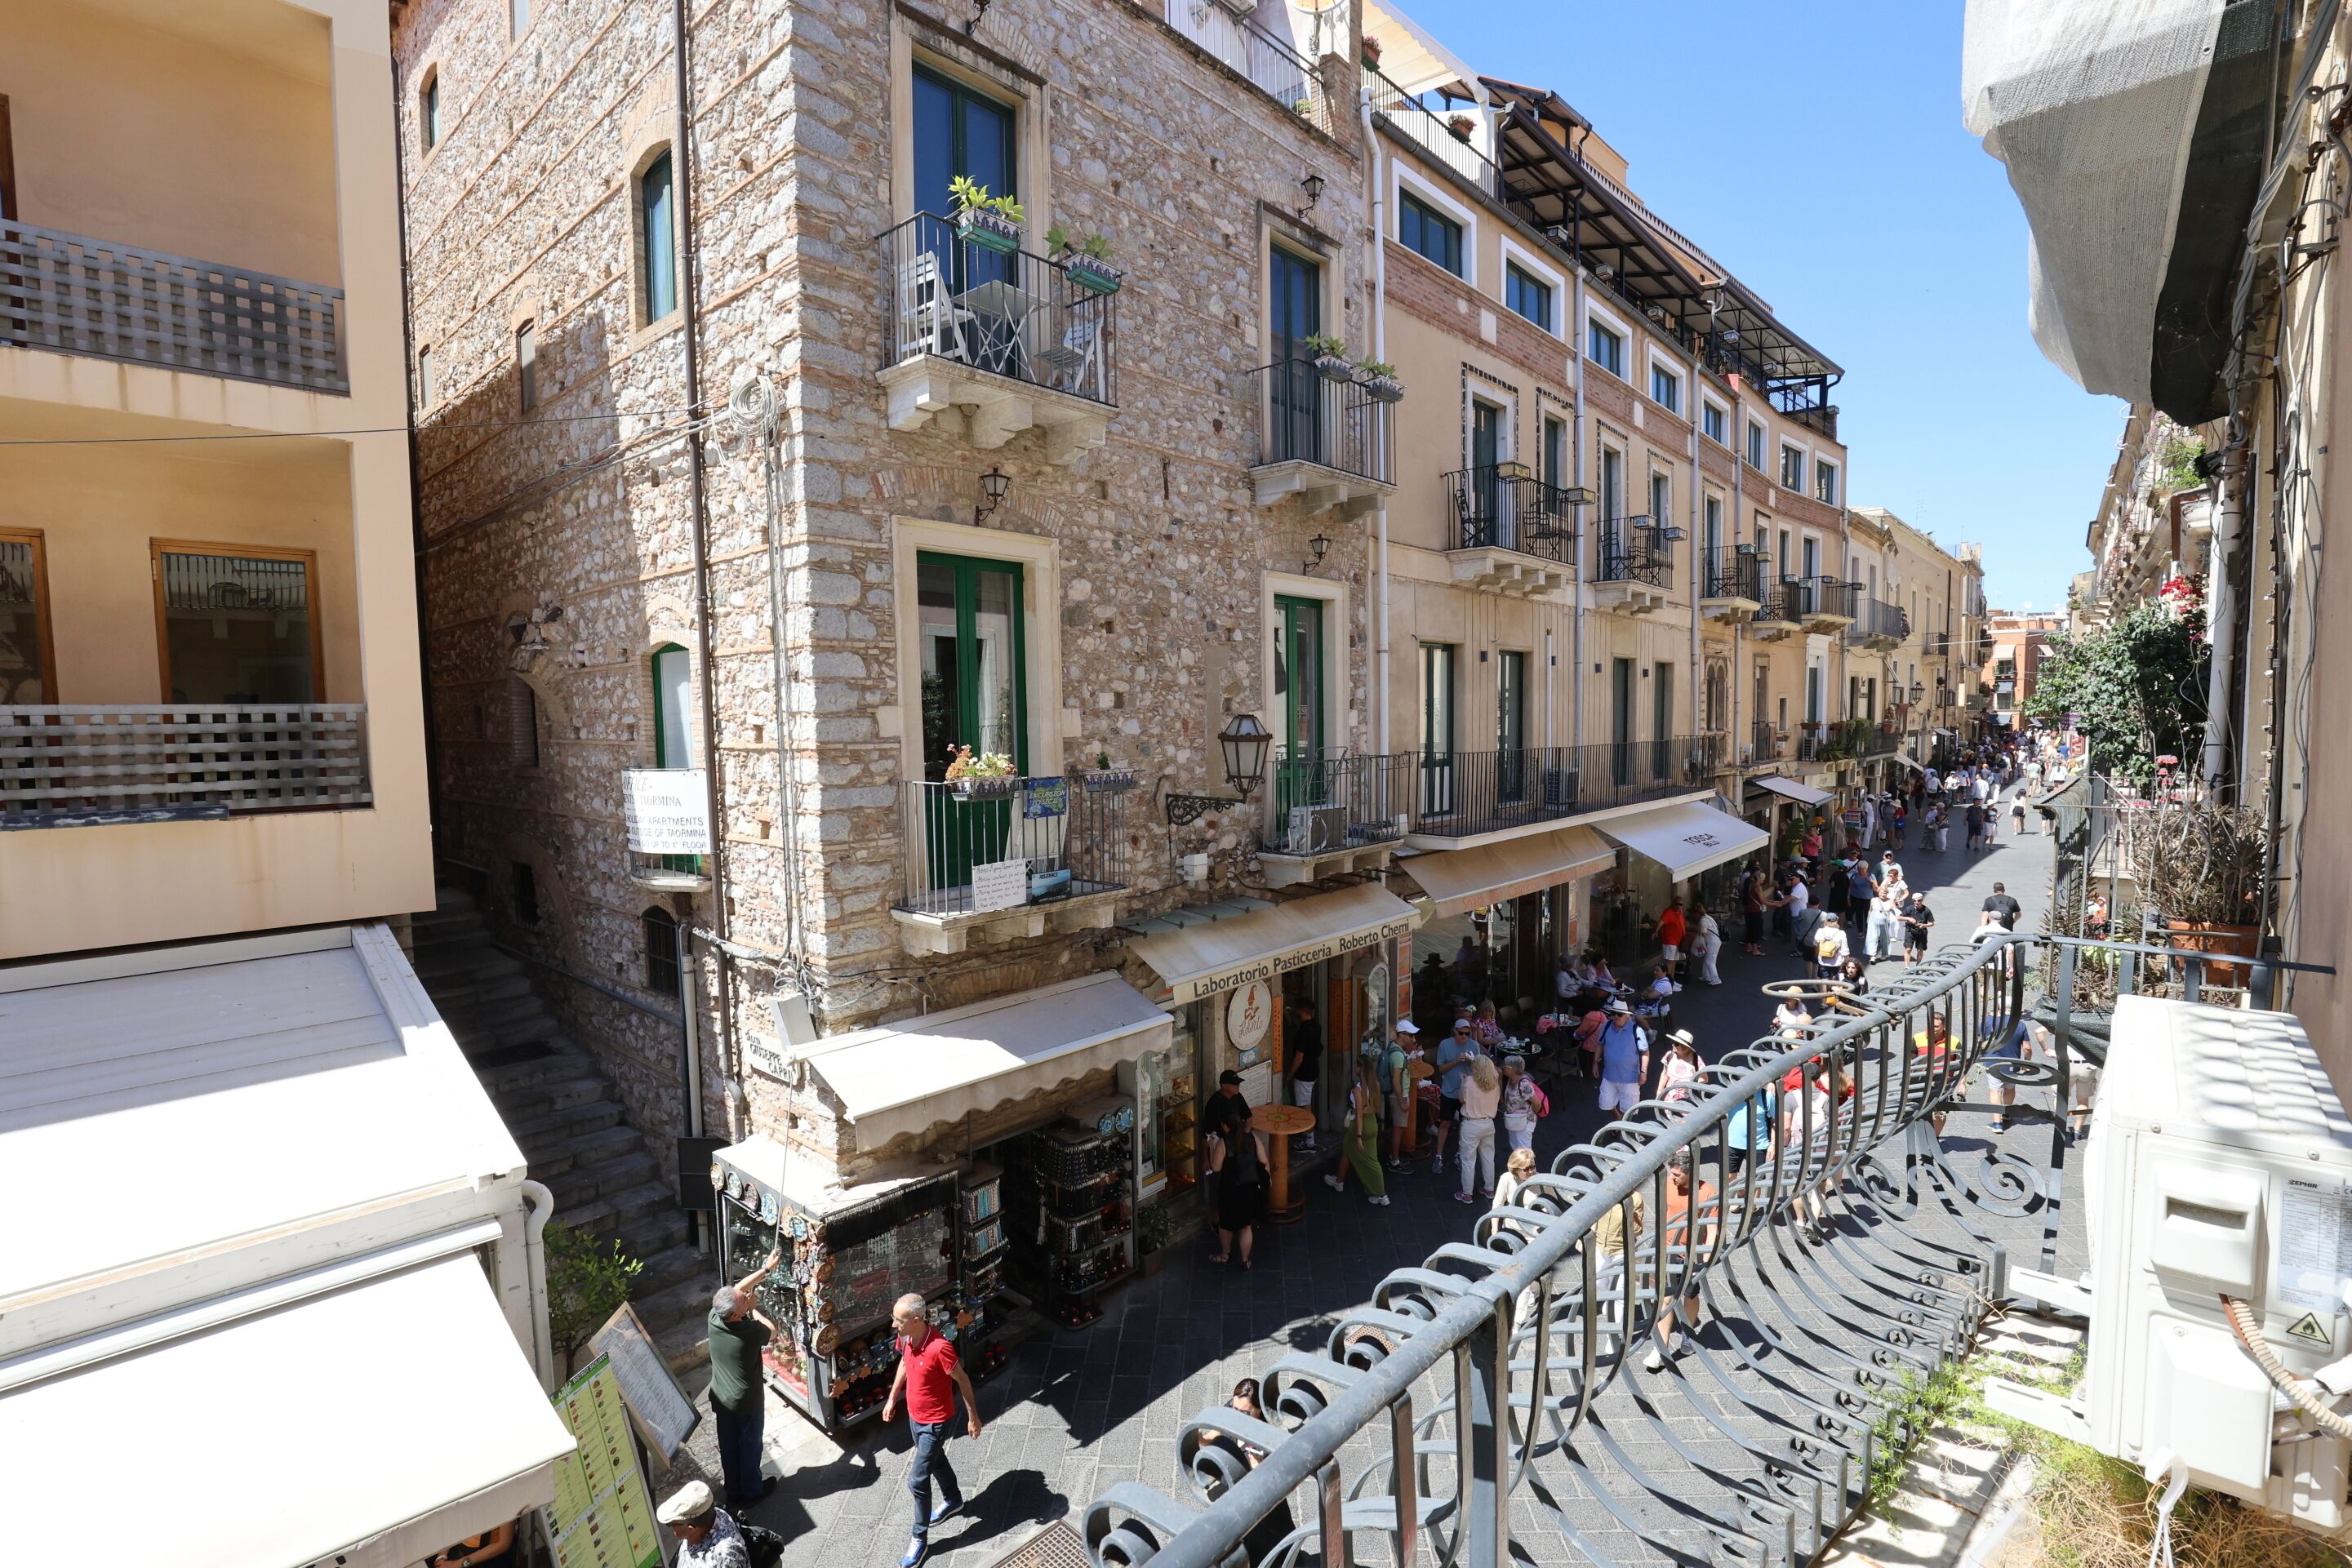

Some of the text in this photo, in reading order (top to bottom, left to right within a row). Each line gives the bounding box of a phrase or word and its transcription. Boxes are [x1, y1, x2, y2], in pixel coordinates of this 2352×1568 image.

[623, 776, 648, 791] OFFICE
[1029, 790, 1065, 798] EXCURSION
[640, 795, 682, 806] TAORMINA
[648, 816, 704, 826] APARTMENTS
[668, 828, 706, 837] TAORMINA
[1682, 833, 1716, 845] TOSCA
[1194, 919, 1409, 998] Laboratorio Pasticceria Roberto Chemi
[750, 1043, 782, 1066] GIUSEPPE
[2288, 1180, 2318, 1188] ZEPHIR
[589, 1353, 607, 1370] SICILIANO
